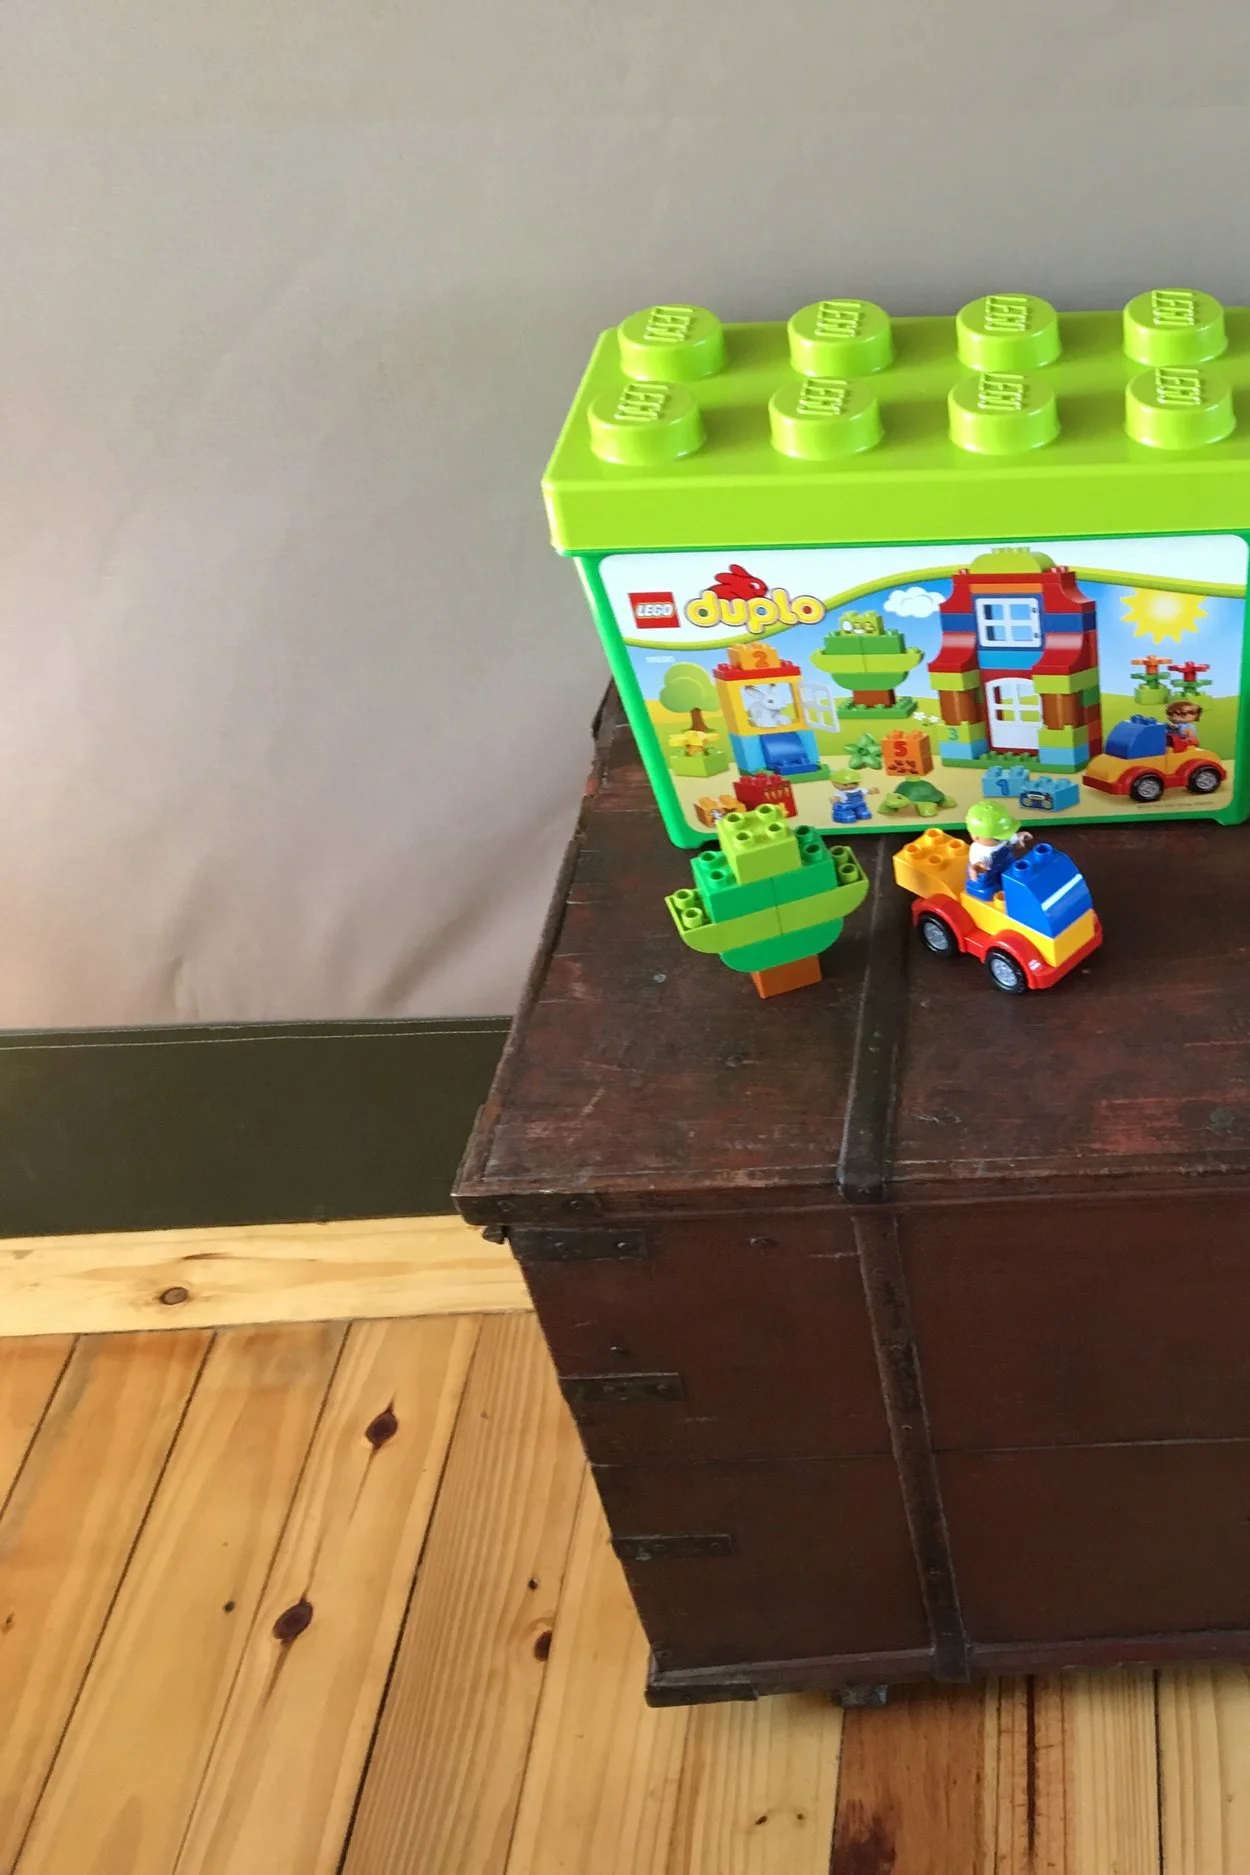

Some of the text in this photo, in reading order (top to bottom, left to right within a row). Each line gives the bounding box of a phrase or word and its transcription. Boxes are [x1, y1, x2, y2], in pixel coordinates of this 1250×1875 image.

[635, 587, 826, 634] LEGO duplo
[751, 650, 770, 669] 2
[947, 727, 958, 741] 3
[893, 740, 908, 757] 5
